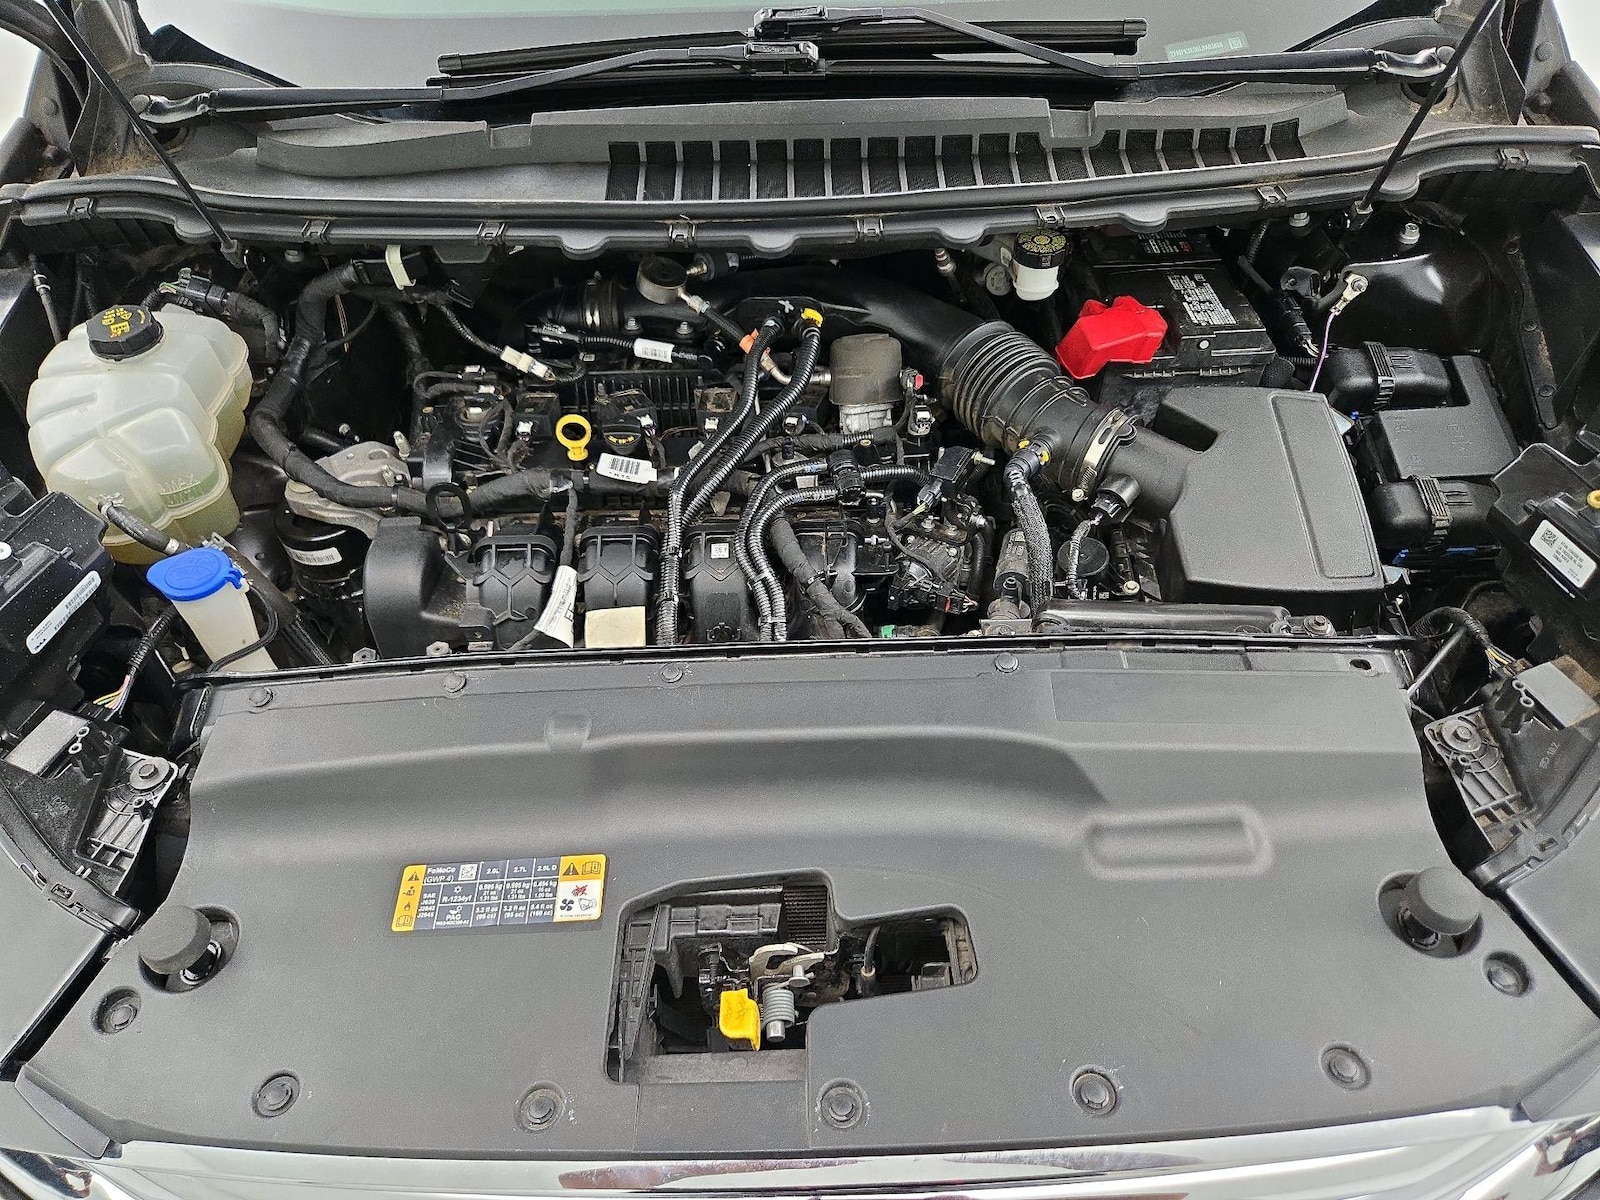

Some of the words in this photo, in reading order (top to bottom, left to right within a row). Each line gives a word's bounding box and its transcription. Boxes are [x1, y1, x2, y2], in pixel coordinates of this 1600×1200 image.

[427, 866, 457, 874] FoMoCo
[424, 875, 446, 884] (GWP
[446, 874, 454, 884] 4)
